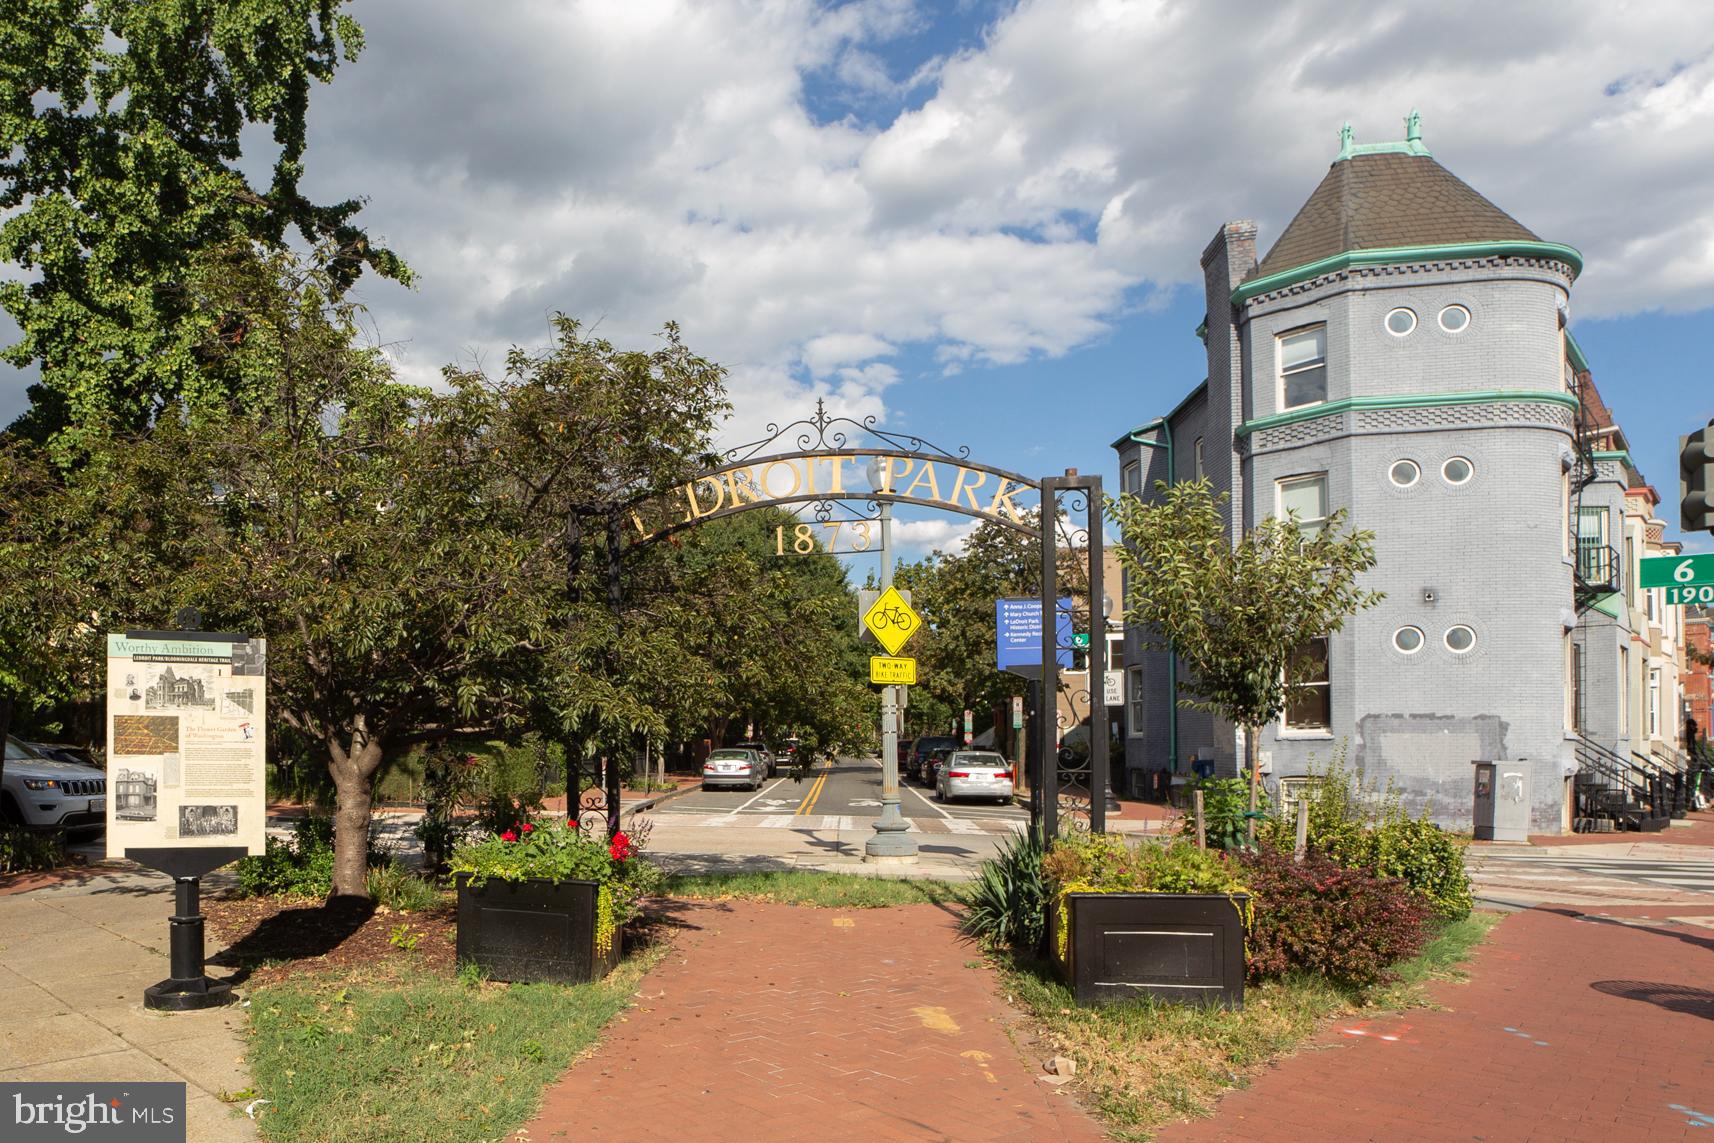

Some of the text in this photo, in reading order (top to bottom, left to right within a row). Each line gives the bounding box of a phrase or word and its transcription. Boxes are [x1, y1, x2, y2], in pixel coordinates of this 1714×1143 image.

[884, 456, 1033, 525] PARK
[775, 520, 872, 557] 1873
[1674, 559, 1695, 582] 6
[1671, 586, 1714, 604] 190
[116, 641, 214, 655] Worthy Ambition
[875, 671, 912, 680] BIKE TRAFFIC
